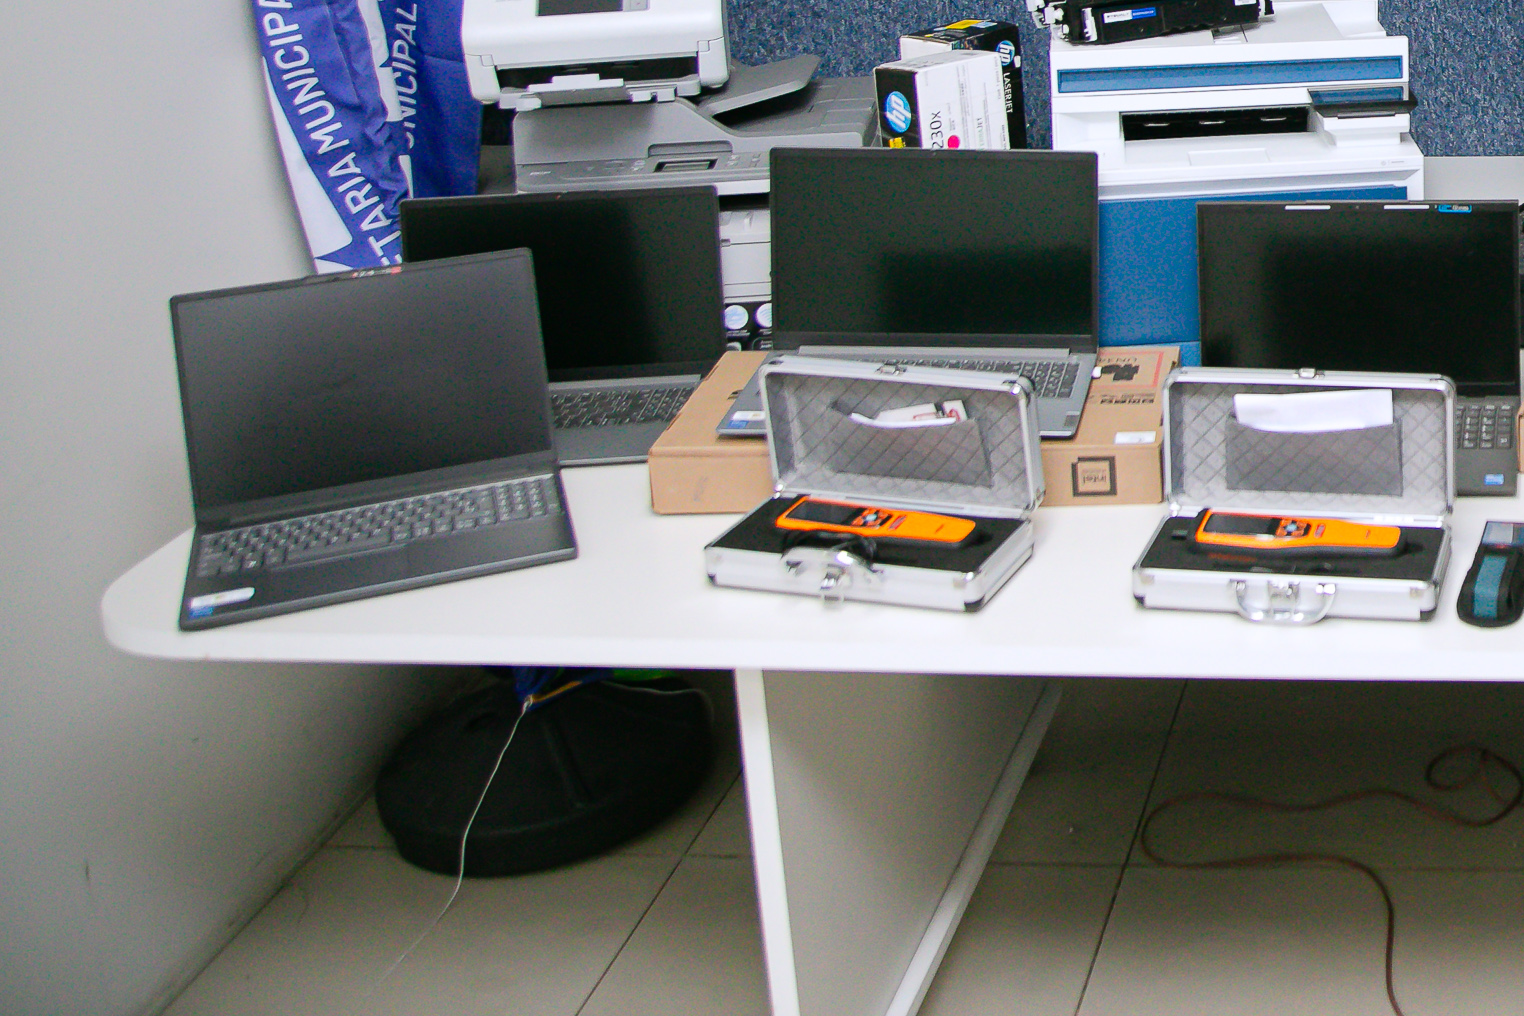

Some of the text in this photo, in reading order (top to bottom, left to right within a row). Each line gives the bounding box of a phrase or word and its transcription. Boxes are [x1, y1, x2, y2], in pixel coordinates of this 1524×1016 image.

[999, 42, 1014, 67] hp
[1003, 72, 1013, 113] LASERJET
[886, 93, 912, 131] hp
